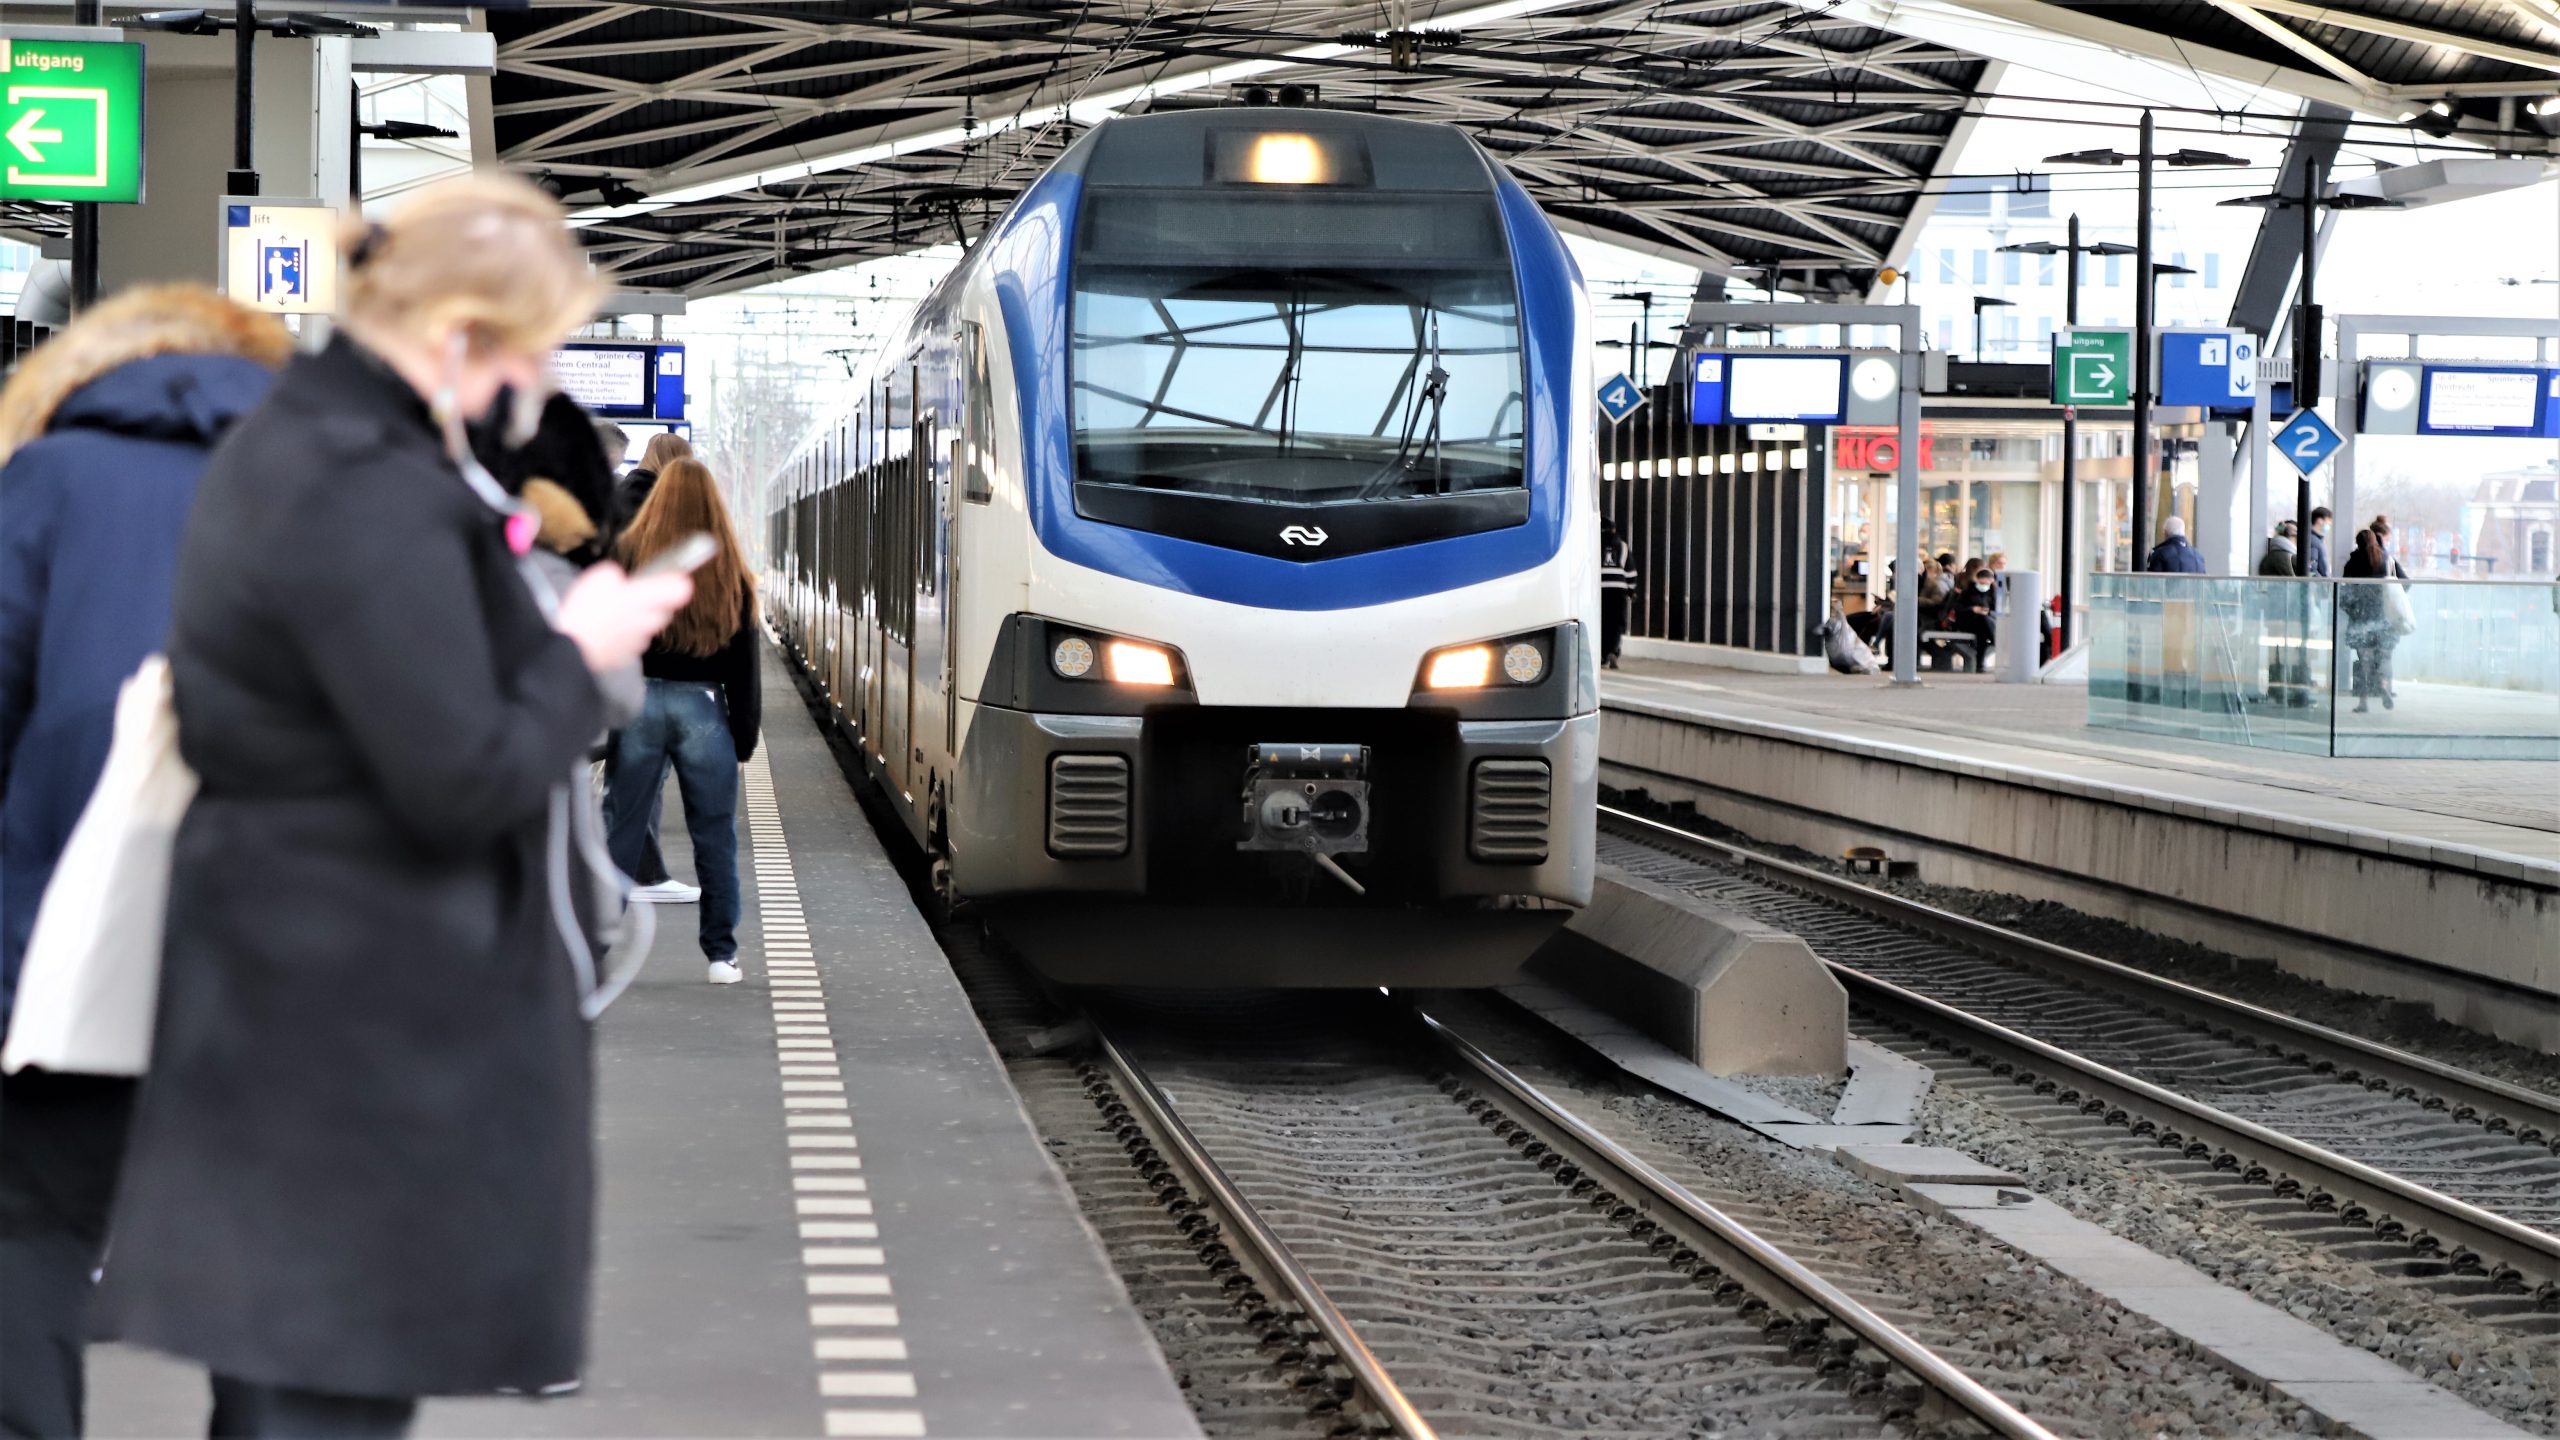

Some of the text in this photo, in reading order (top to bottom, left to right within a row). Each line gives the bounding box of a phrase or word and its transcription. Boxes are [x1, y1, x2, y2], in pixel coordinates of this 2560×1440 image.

[14, 51, 85, 72] uitgang
[253, 213, 271, 225] lift
[2073, 337, 2105, 347] uitgang
[594, 352, 625, 361] Sprinter
[2209, 349, 2217, 362] 1
[576, 360, 611, 369] Centraal
[668, 361, 674, 372] 1
[1606, 386, 1628, 408] 4
[2295, 425, 2320, 457] 2
[1837, 435, 1934, 471] KIOK
